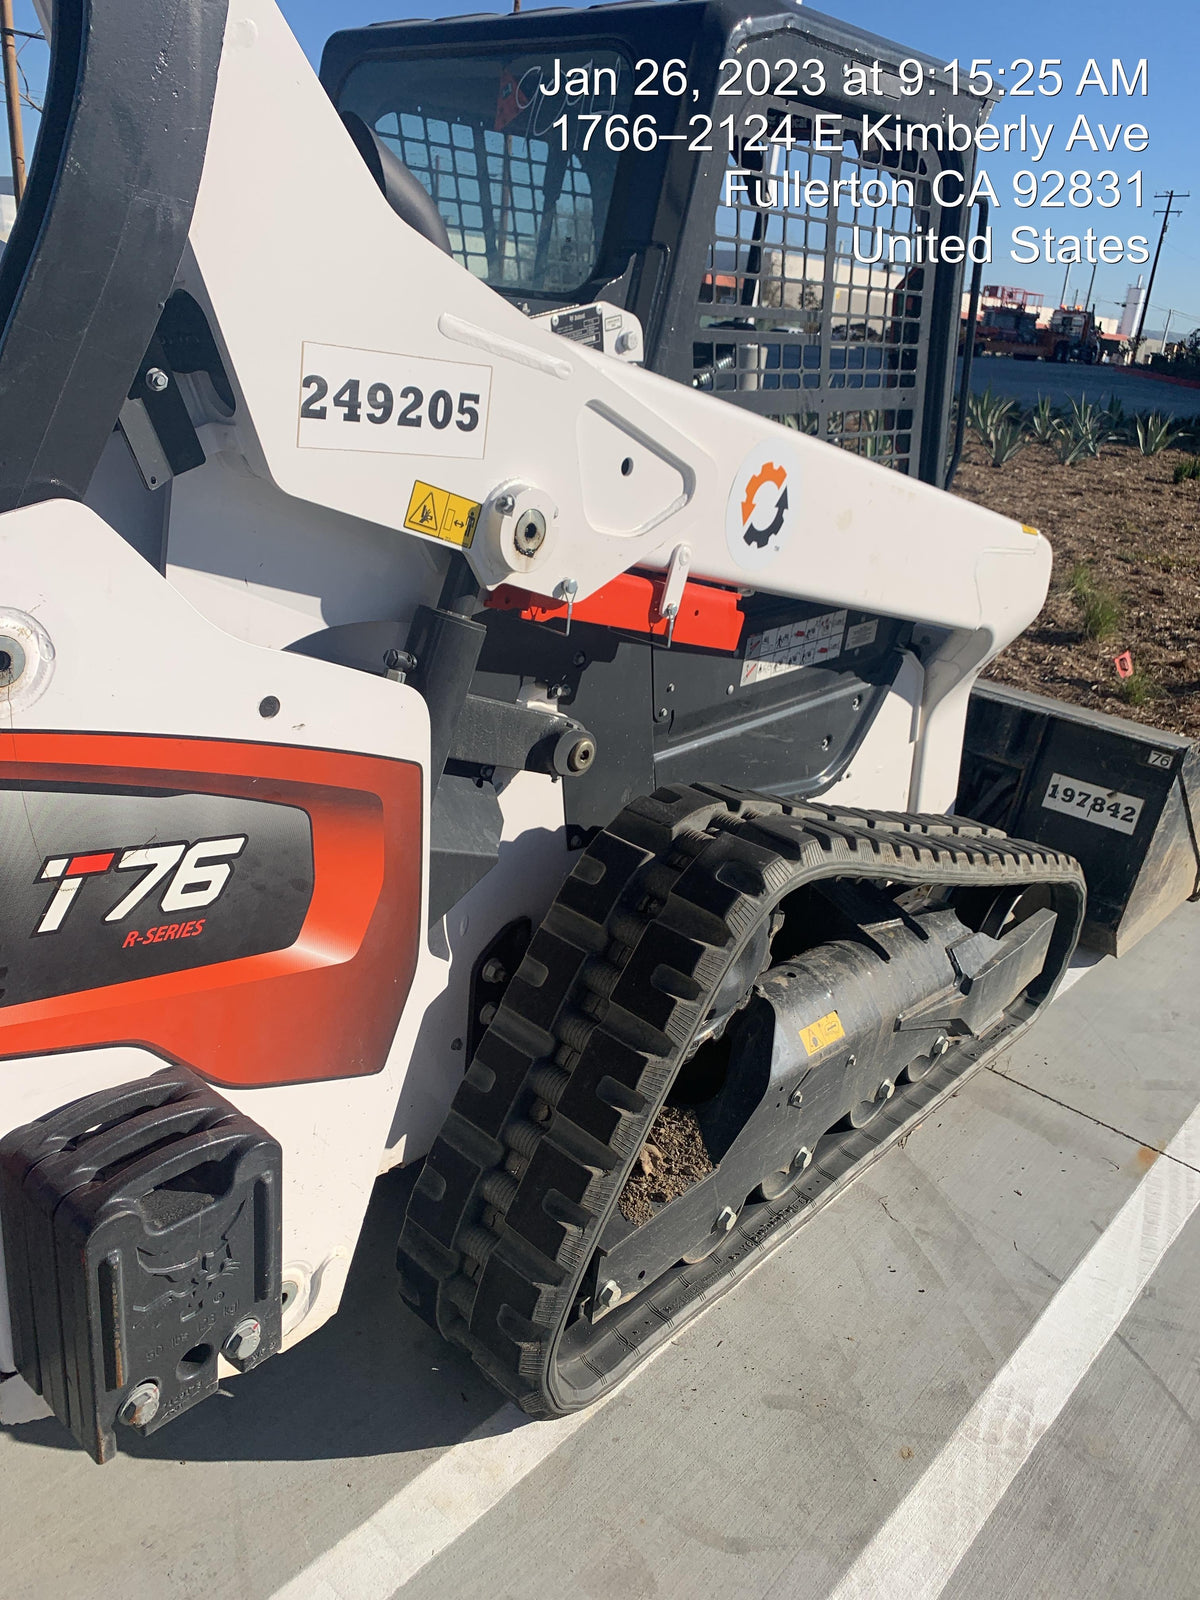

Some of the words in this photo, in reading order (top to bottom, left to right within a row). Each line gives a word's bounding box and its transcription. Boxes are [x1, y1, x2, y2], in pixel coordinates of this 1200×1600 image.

[300, 374, 480, 432] 249205
[1150, 752, 1171, 767] 76
[1047, 783, 1136, 823] 197842
[33, 833, 249, 938] T76
[122, 919, 206, 948] R-SERIES
